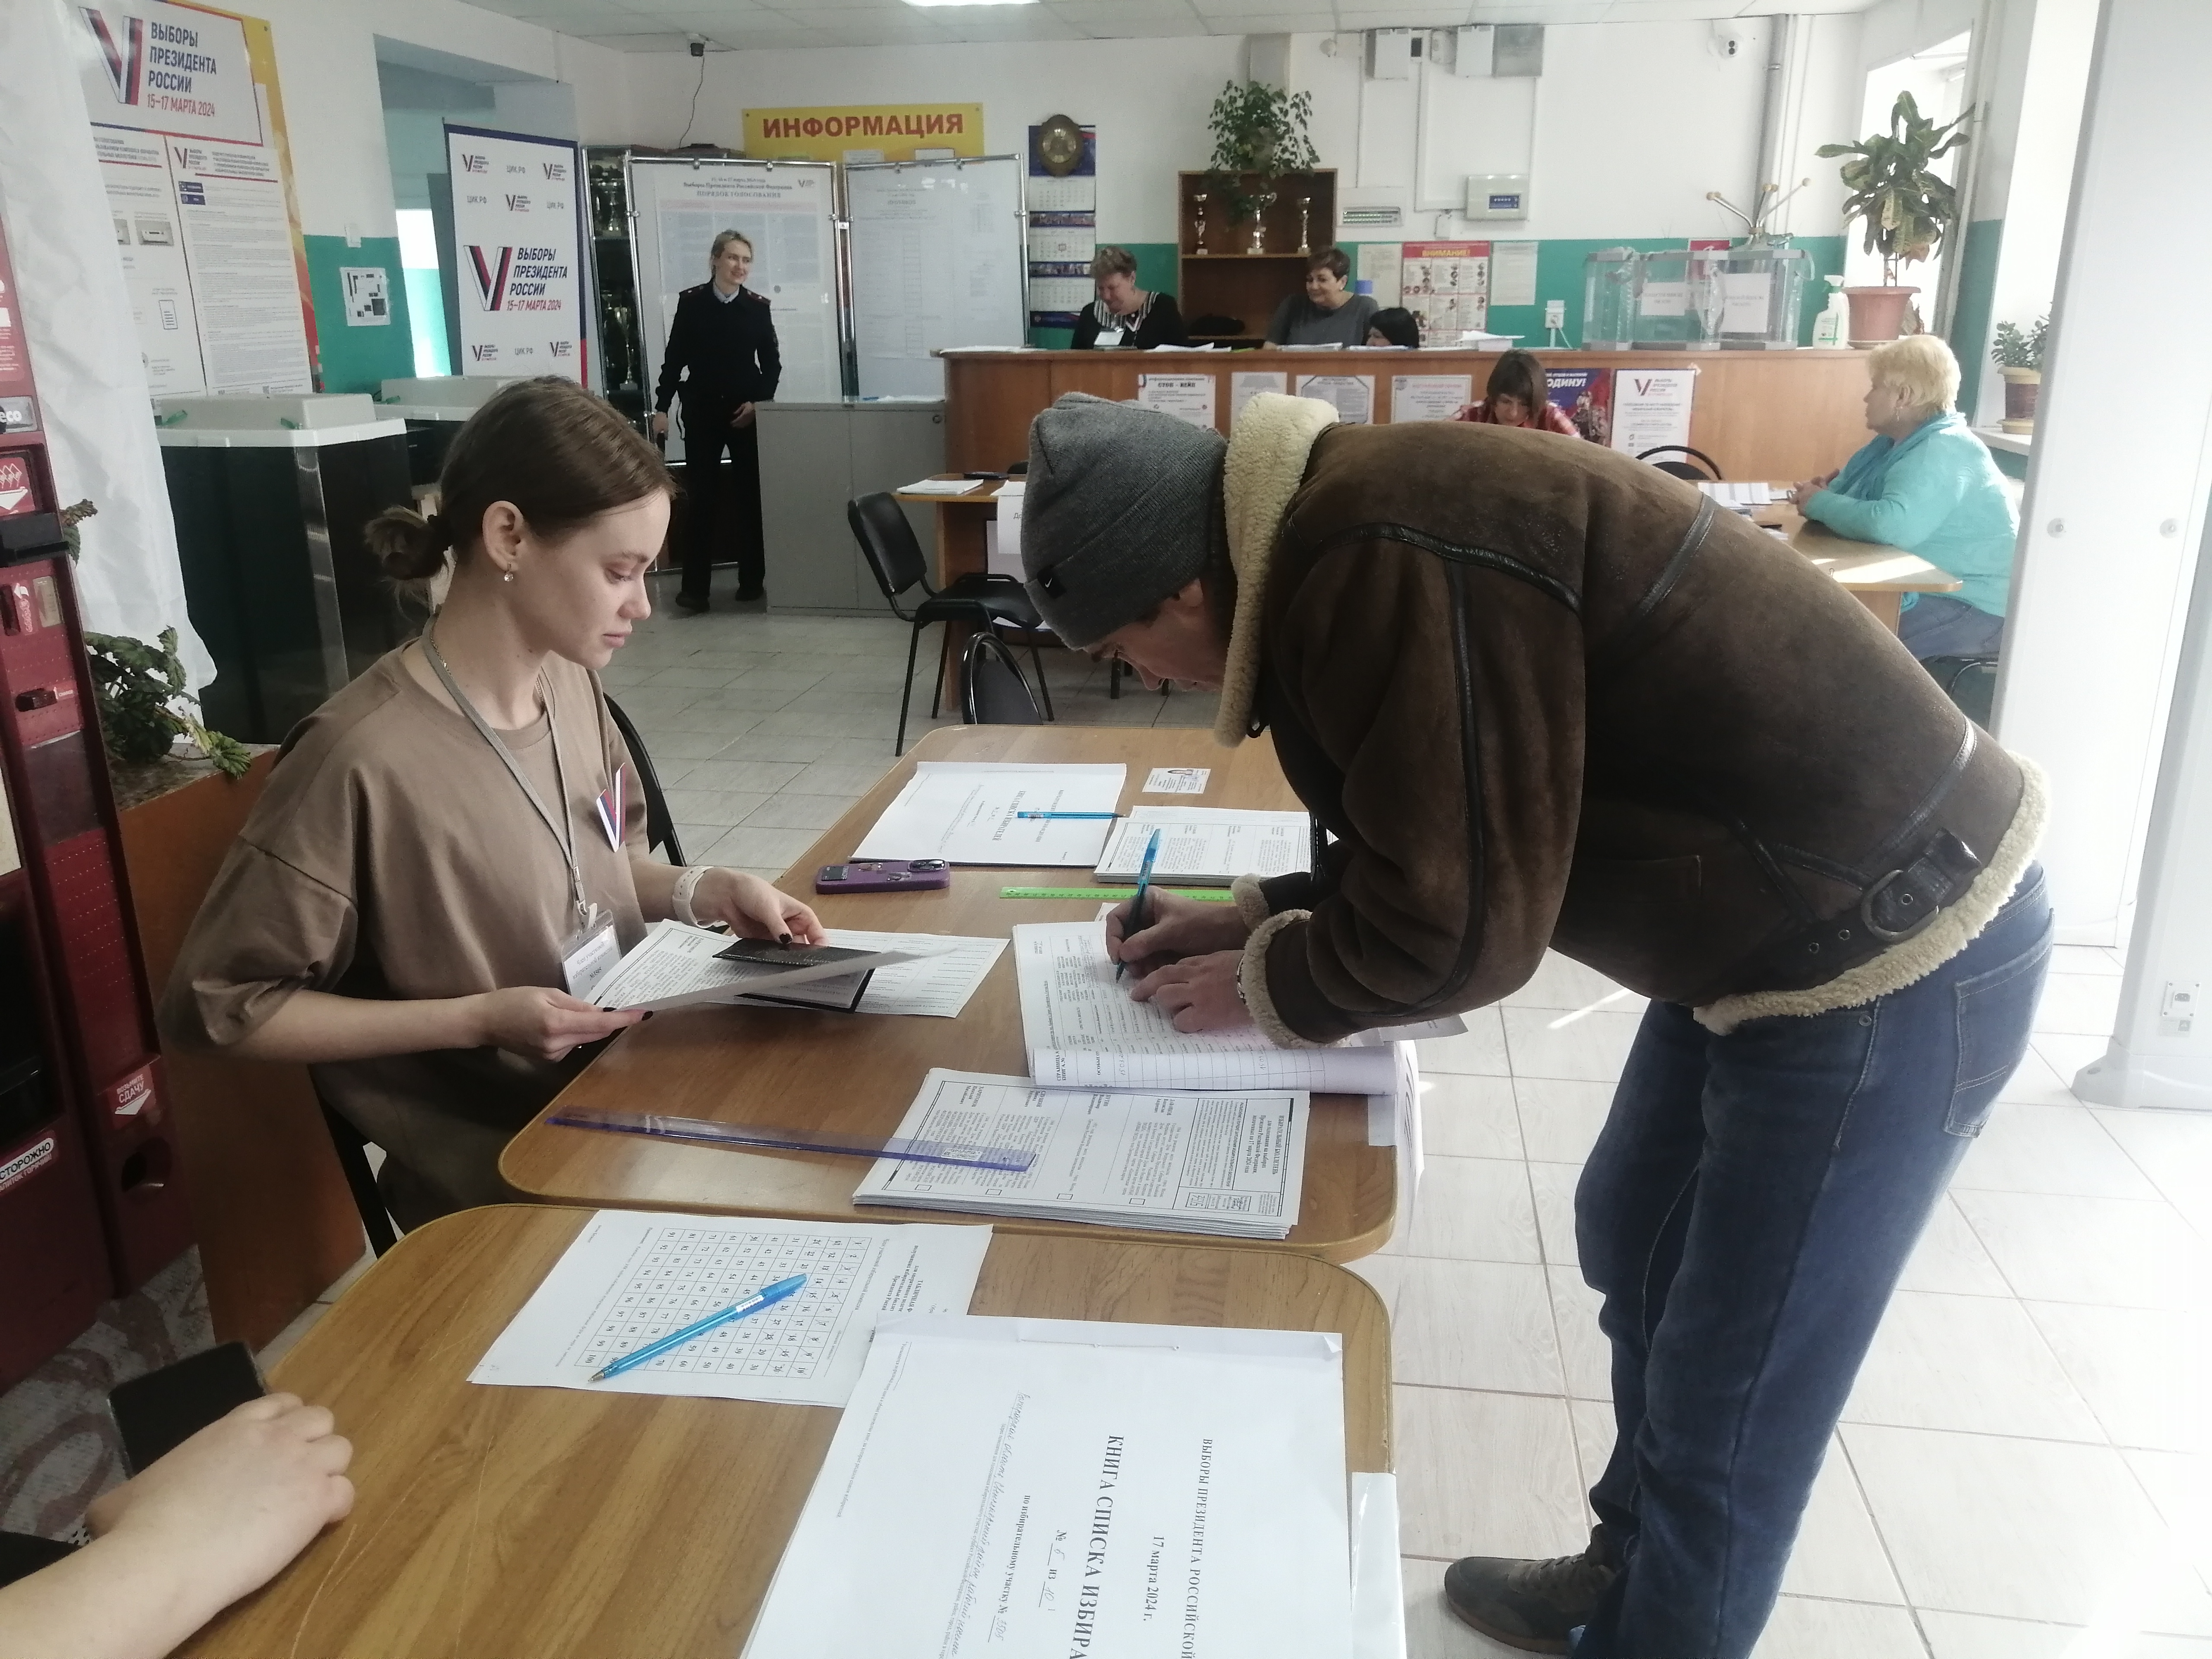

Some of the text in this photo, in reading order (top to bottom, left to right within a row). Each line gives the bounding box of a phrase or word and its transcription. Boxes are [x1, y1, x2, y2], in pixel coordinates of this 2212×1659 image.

[151, 22, 198, 47] ВЫБОРЫ
[149, 46, 216, 74] ПРЕЗИДЕНТА
[148, 70, 192, 93] РОССИИ
[171, 97, 196, 114] МАРТА
[198, 102, 215, 117] 2024
[763, 113, 964, 139] ИНФОРМАЦИЯ
[518, 248, 556, 261] ВЫБОРЫ
[514, 265, 568, 280] ПРЕЗИДЕНТА
[510, 283, 546, 296] РОССИИ
[525, 300, 546, 311] МАРТА
[547, 299, 562, 310] 2024
[1547, 378, 1587, 389] ОДИНУ!
[1006, 801, 1020, 817] СПИСКА
[992, 817, 1012, 841] ИЗБИРАТЕЛЕЙ
[116, 1074, 144, 1094] ВОЗЬМИТЕ
[119, 1081, 144, 1103] СДАЧУ
[1036, 1090, 1046, 1107] СЛУЦКИЙ
[1103, 1095, 1111, 1106] ПУТИН
[1166, 1099, 1175, 1116] ДАВАНКОВ
[1255, 1133, 1264, 1153] Российской
[1272, 1116, 1284, 1175] ИЗБИРАТЕЛЬНЫЙ БЮЛЛЕТЕНЬ
[0, 1142, 51, 1179] СТОРОЖНО
[887, 1275, 900, 1297] Президента
[895, 1269, 910, 1297] избирательные
[903, 1273, 917, 1299] оперативного
[908, 1280, 923, 1307] ТАБЛИЧНАЯ
[585, 1354, 596, 1363] 100
[1055, 1530, 1067, 1541] №
[1152, 1536, 1165, 1547] 17
[998, 1495, 1031, 1614] по избирательному участку №
[1069, 1435, 1124, 1659] КНИГА СПИСКА ИЗБИРА
[1181, 1439, 1213, 1659] ВЫБОРЫ ПРЕЗИДЕНТА РОССИЙСКОЙ
[1048, 1569, 1057, 1580] из
[1147, 1551, 1160, 1583] марта
[1044, 1587, 1055, 1601] 10
[1145, 1587, 1159, 1610] 2024
